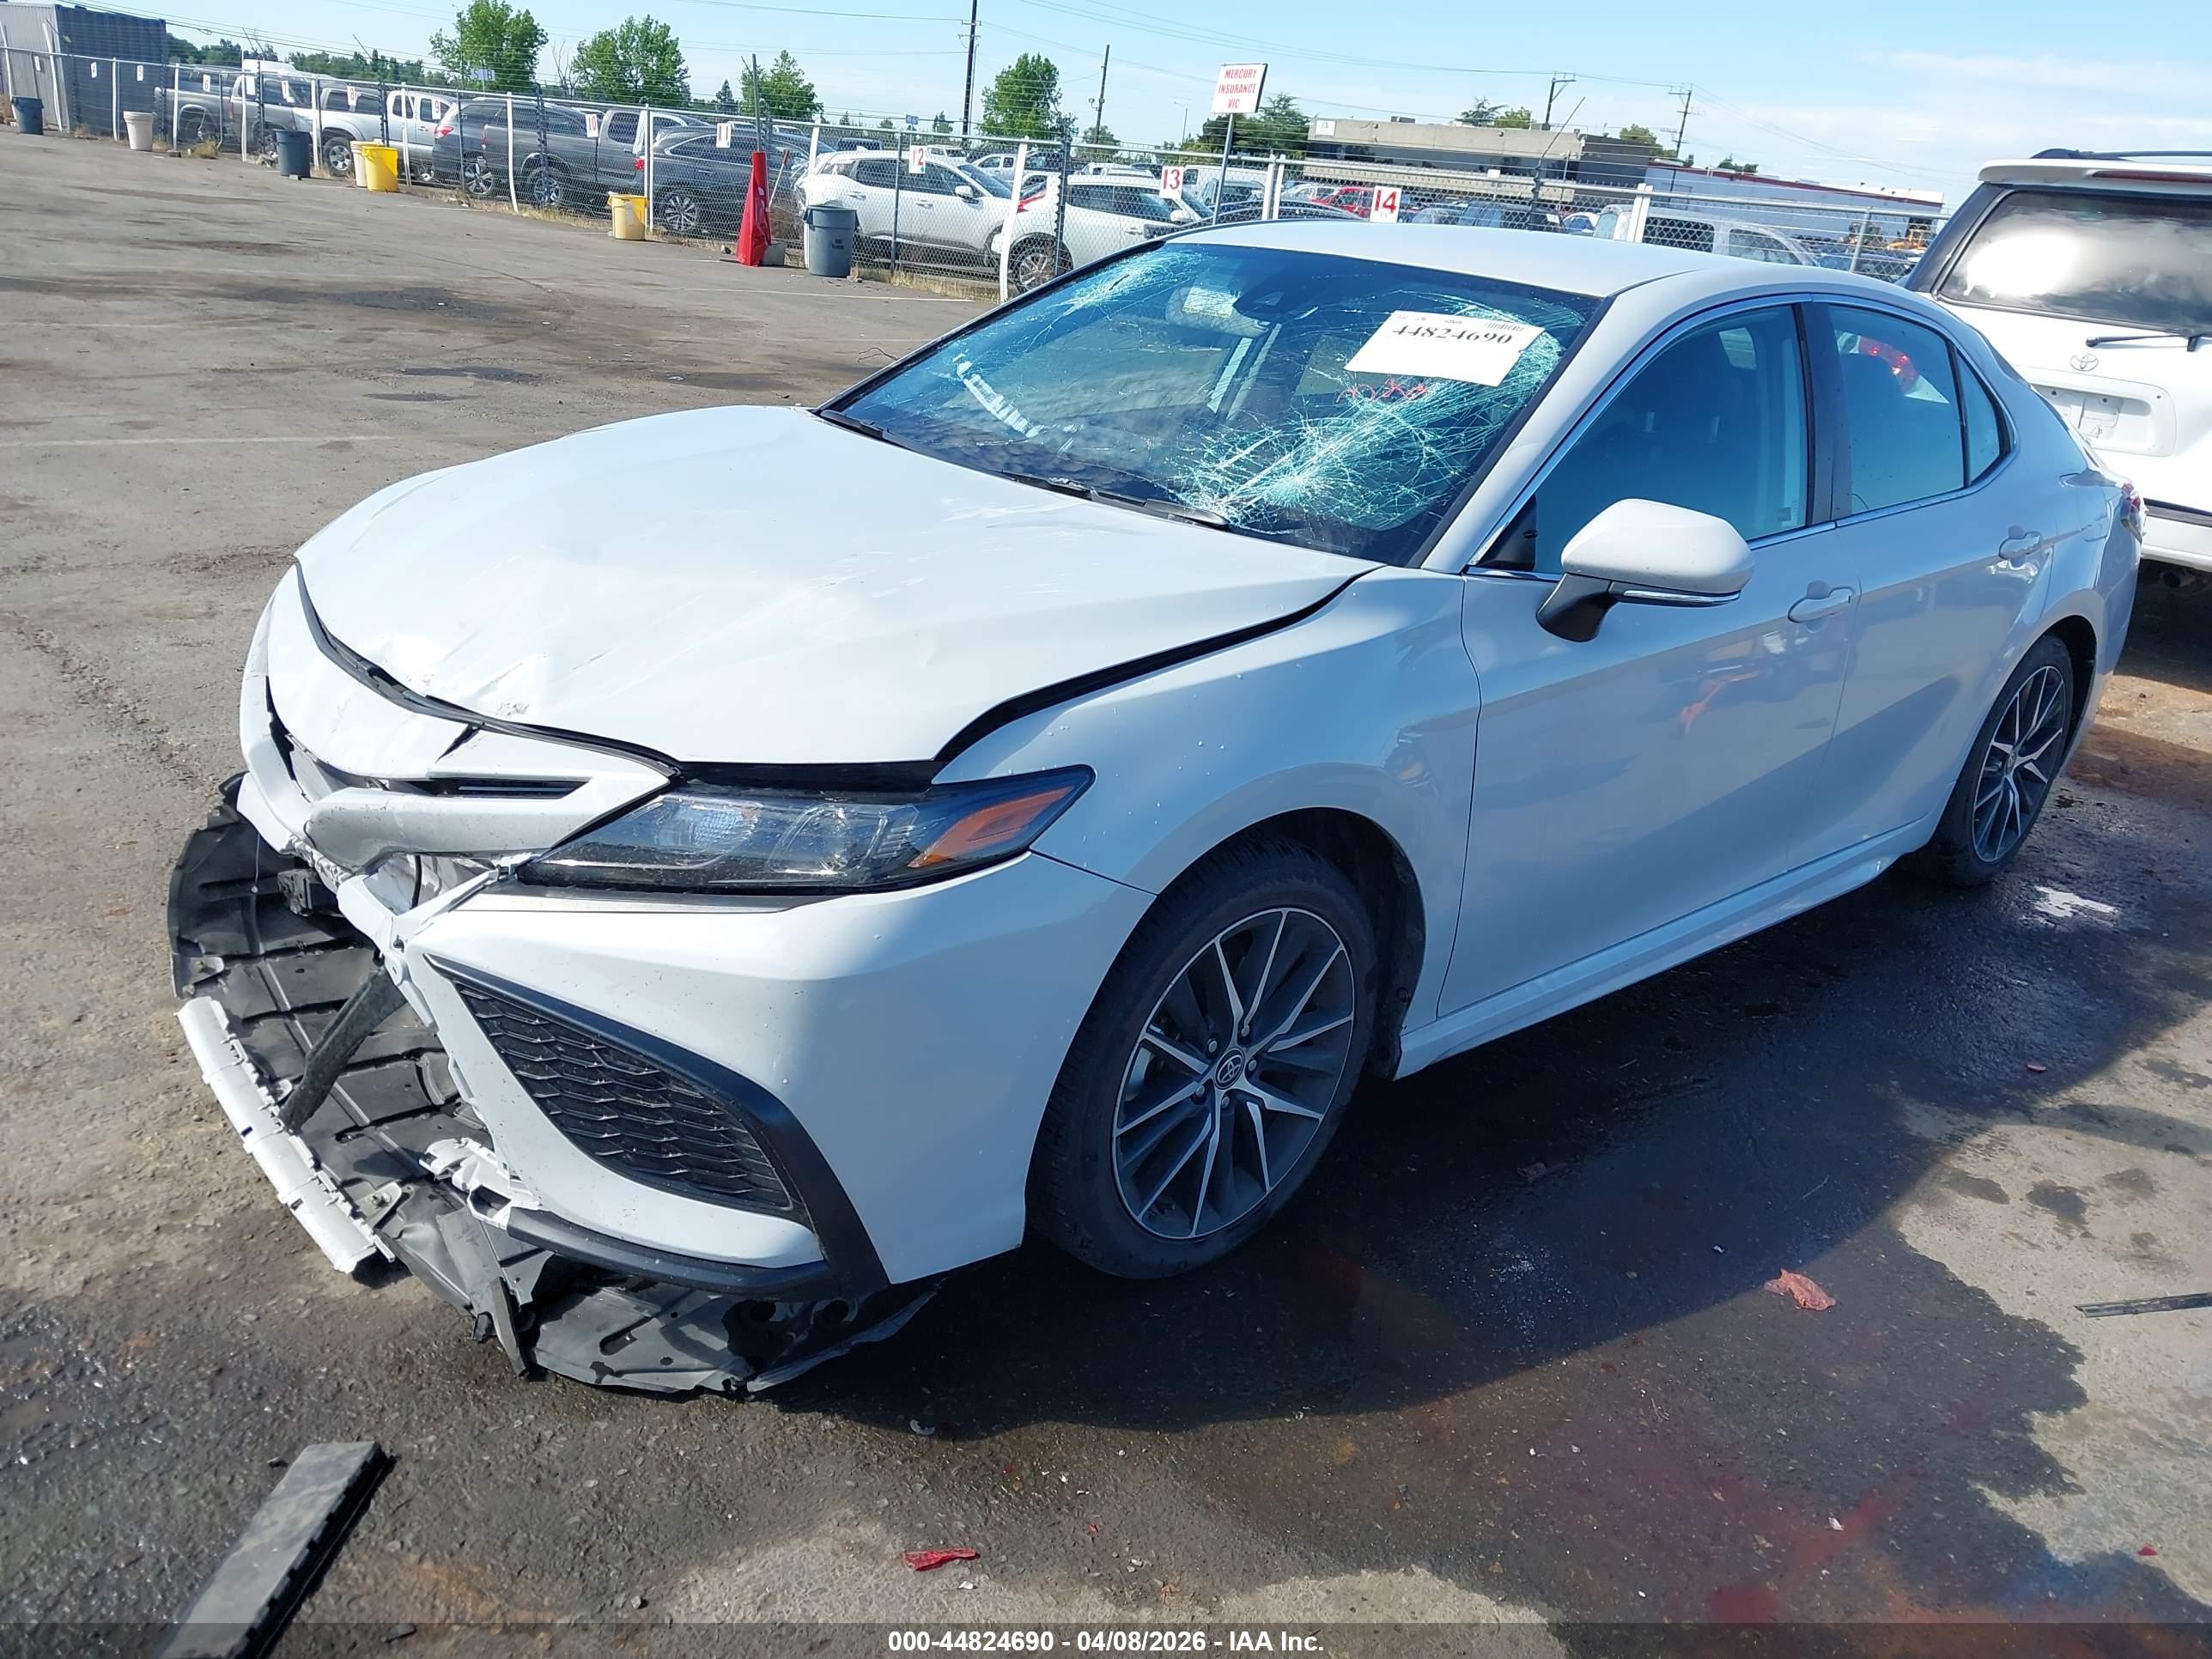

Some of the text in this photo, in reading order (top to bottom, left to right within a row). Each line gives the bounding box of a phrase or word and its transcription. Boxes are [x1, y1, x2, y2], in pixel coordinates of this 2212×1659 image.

[1224, 69, 1257, 79] MERCURY
[1218, 83, 1257, 94] INSURANCE
[434, 100, 440, 113] 9
[587, 117, 597, 131] 10
[913, 148, 924, 166] 12
[1164, 169, 1181, 190] 13
[1375, 190, 1397, 213] 14
[1393, 325, 1512, 343] 44824690
